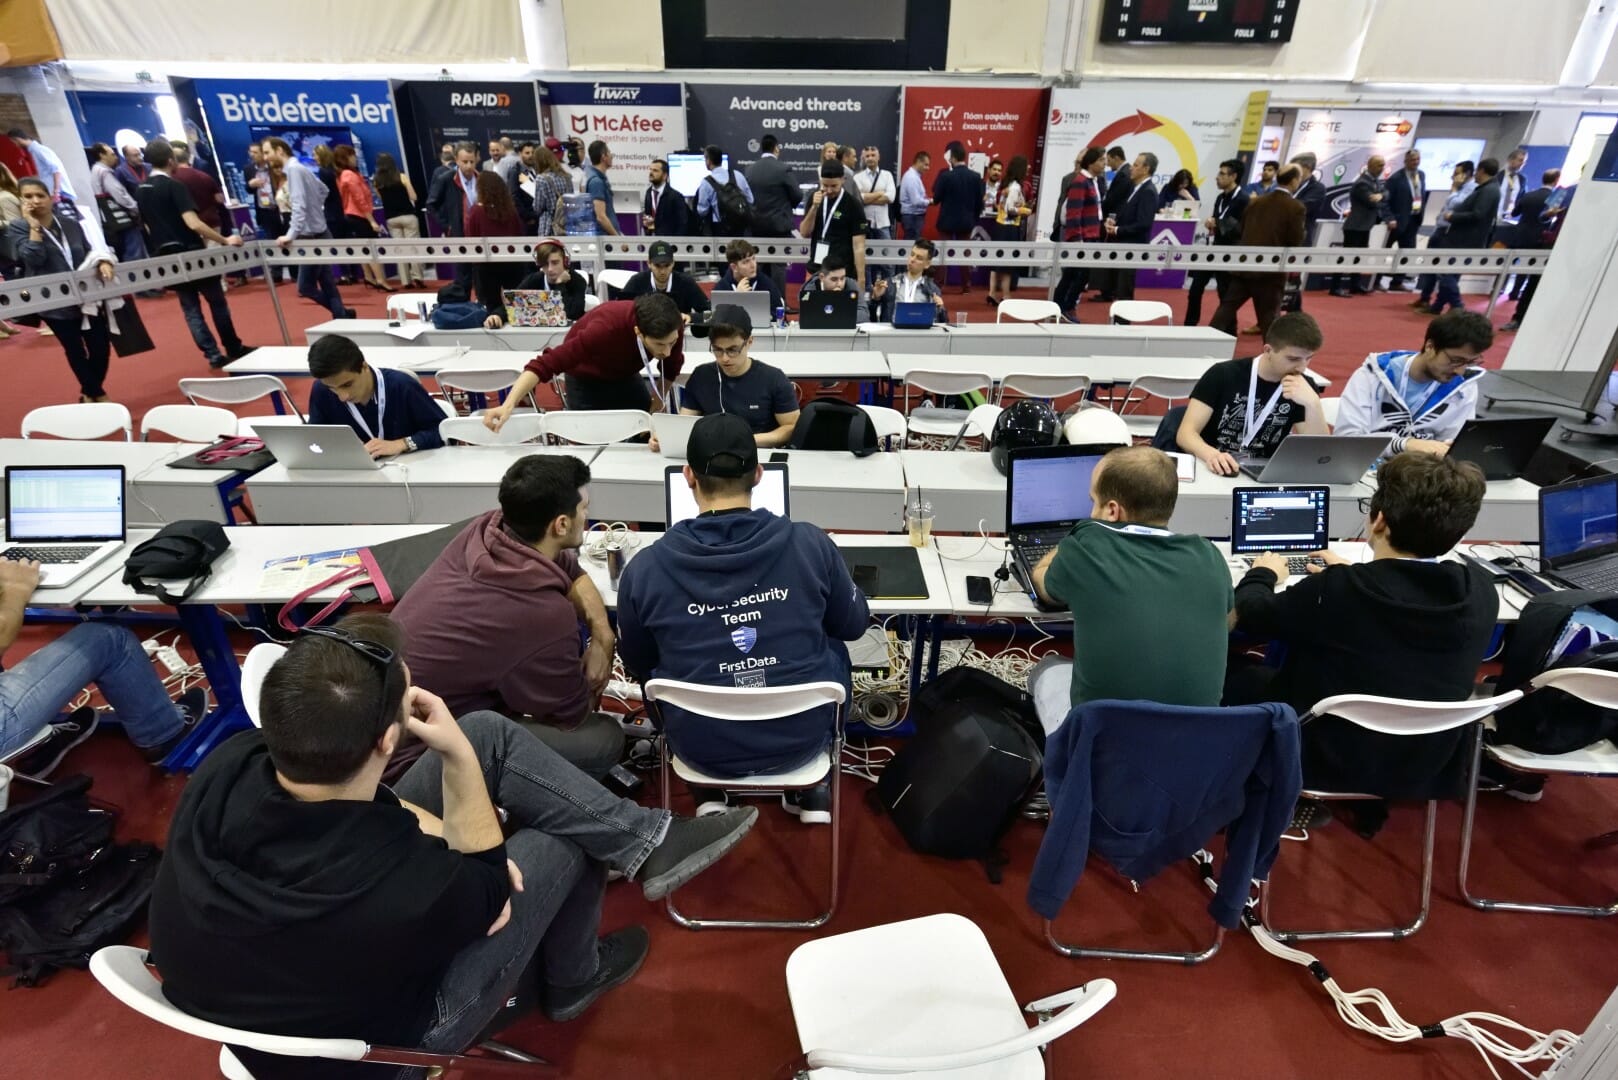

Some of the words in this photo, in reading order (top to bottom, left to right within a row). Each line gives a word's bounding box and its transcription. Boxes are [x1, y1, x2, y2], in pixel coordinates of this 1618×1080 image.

[1120, 13, 1129, 23] 14
[1273, 14, 1283, 24] 14
[1117, 28, 1127, 37] 15
[1141, 27, 1162, 36] FOULS
[1234, 28, 1255, 38] FOULS
[1270, 29, 1280, 39] 15
[216, 92, 392, 123] Bitdefender
[730, 97, 803, 111] Advanced
[806, 97, 862, 112] threats
[1065, 112, 1090, 120] TREND
[593, 114, 664, 132] McAfee
[762, 118, 786, 129] are
[789, 118, 829, 132] gone.
[783, 142, 814, 151] Adaptive
[721, 610, 762, 626] Team
